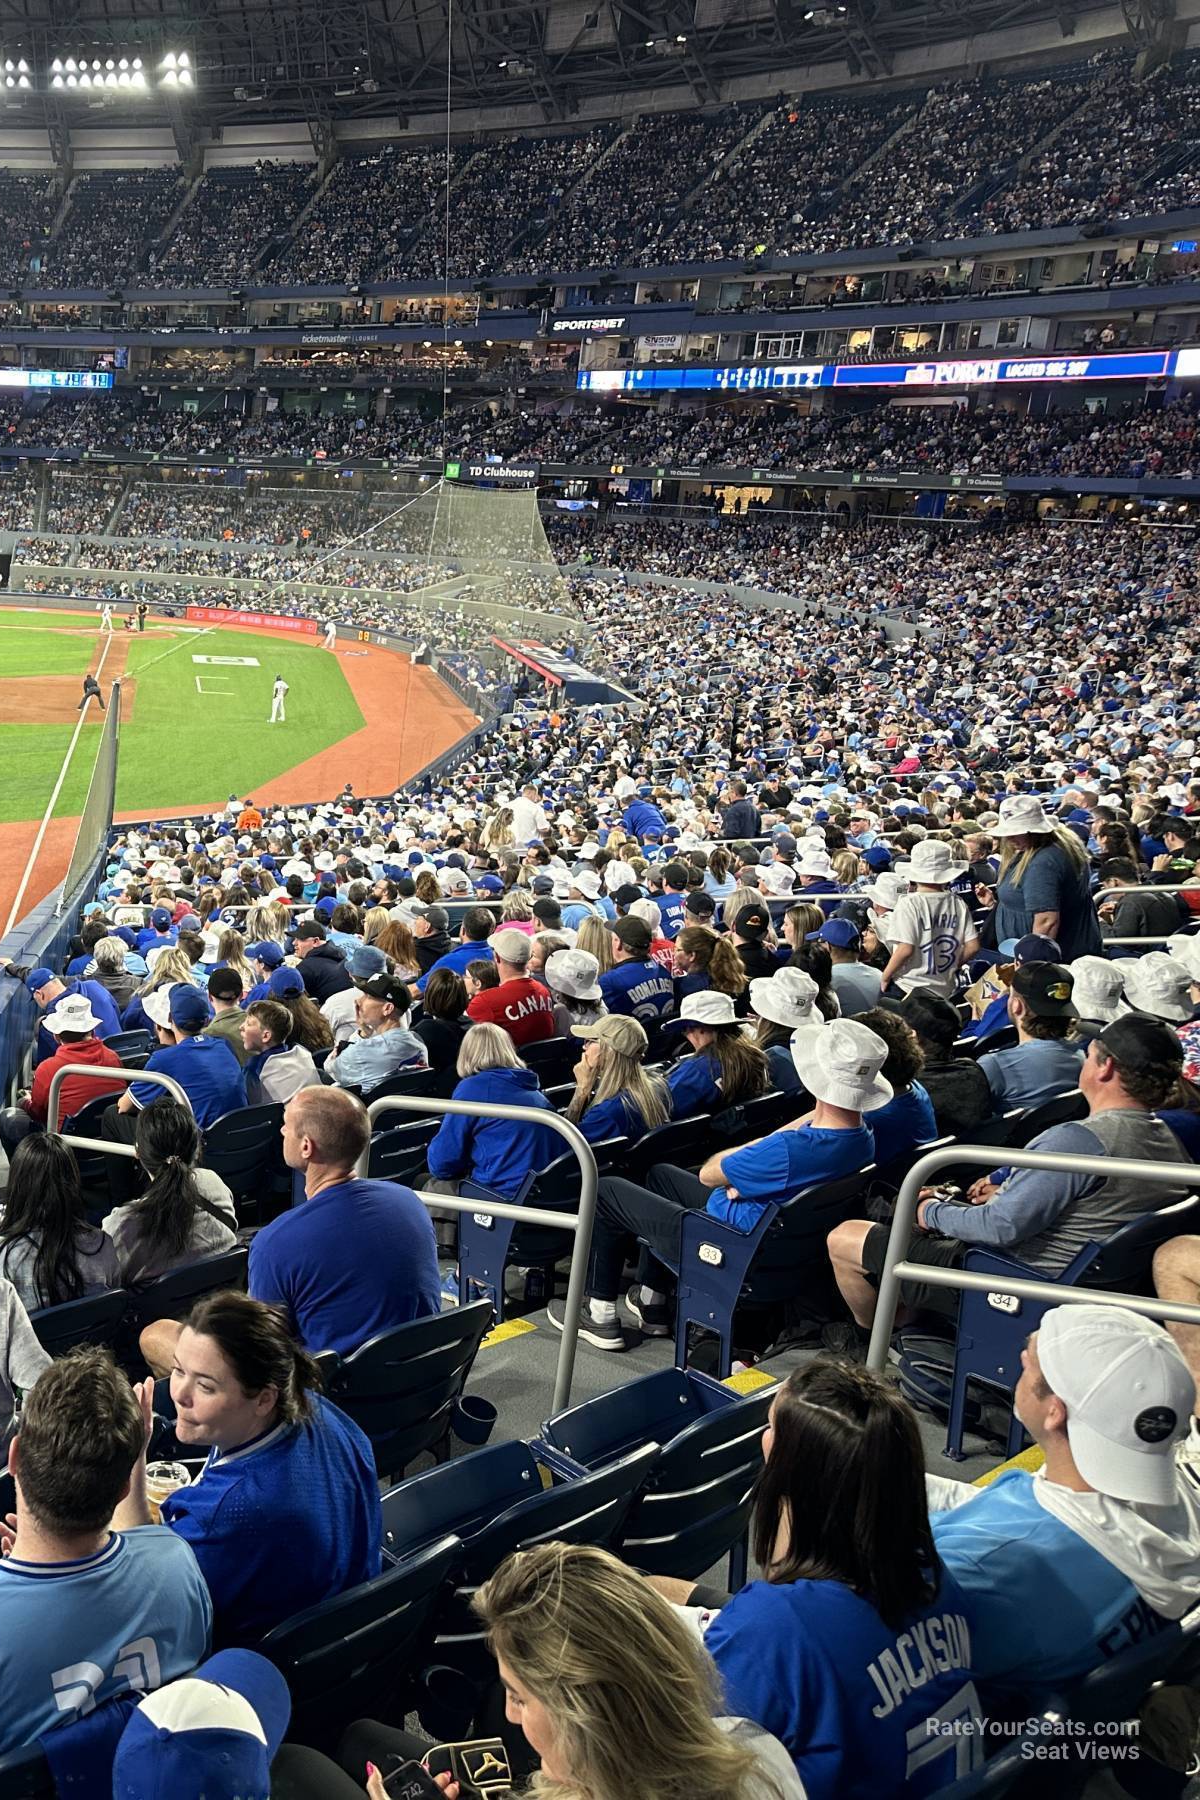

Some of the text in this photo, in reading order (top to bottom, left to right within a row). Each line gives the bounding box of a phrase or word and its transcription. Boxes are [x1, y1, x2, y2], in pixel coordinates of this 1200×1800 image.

[553, 318, 626, 331] SPORTSNET
[935, 361, 1000, 383] PORCH
[469, 466, 535, 478] TD Clubhouse
[920, 934, 960, 976] 13
[703, 1247, 717, 1261] 33
[992, 1293, 1012, 1308] 34
[866, 1613, 972, 1719] JACKSON
